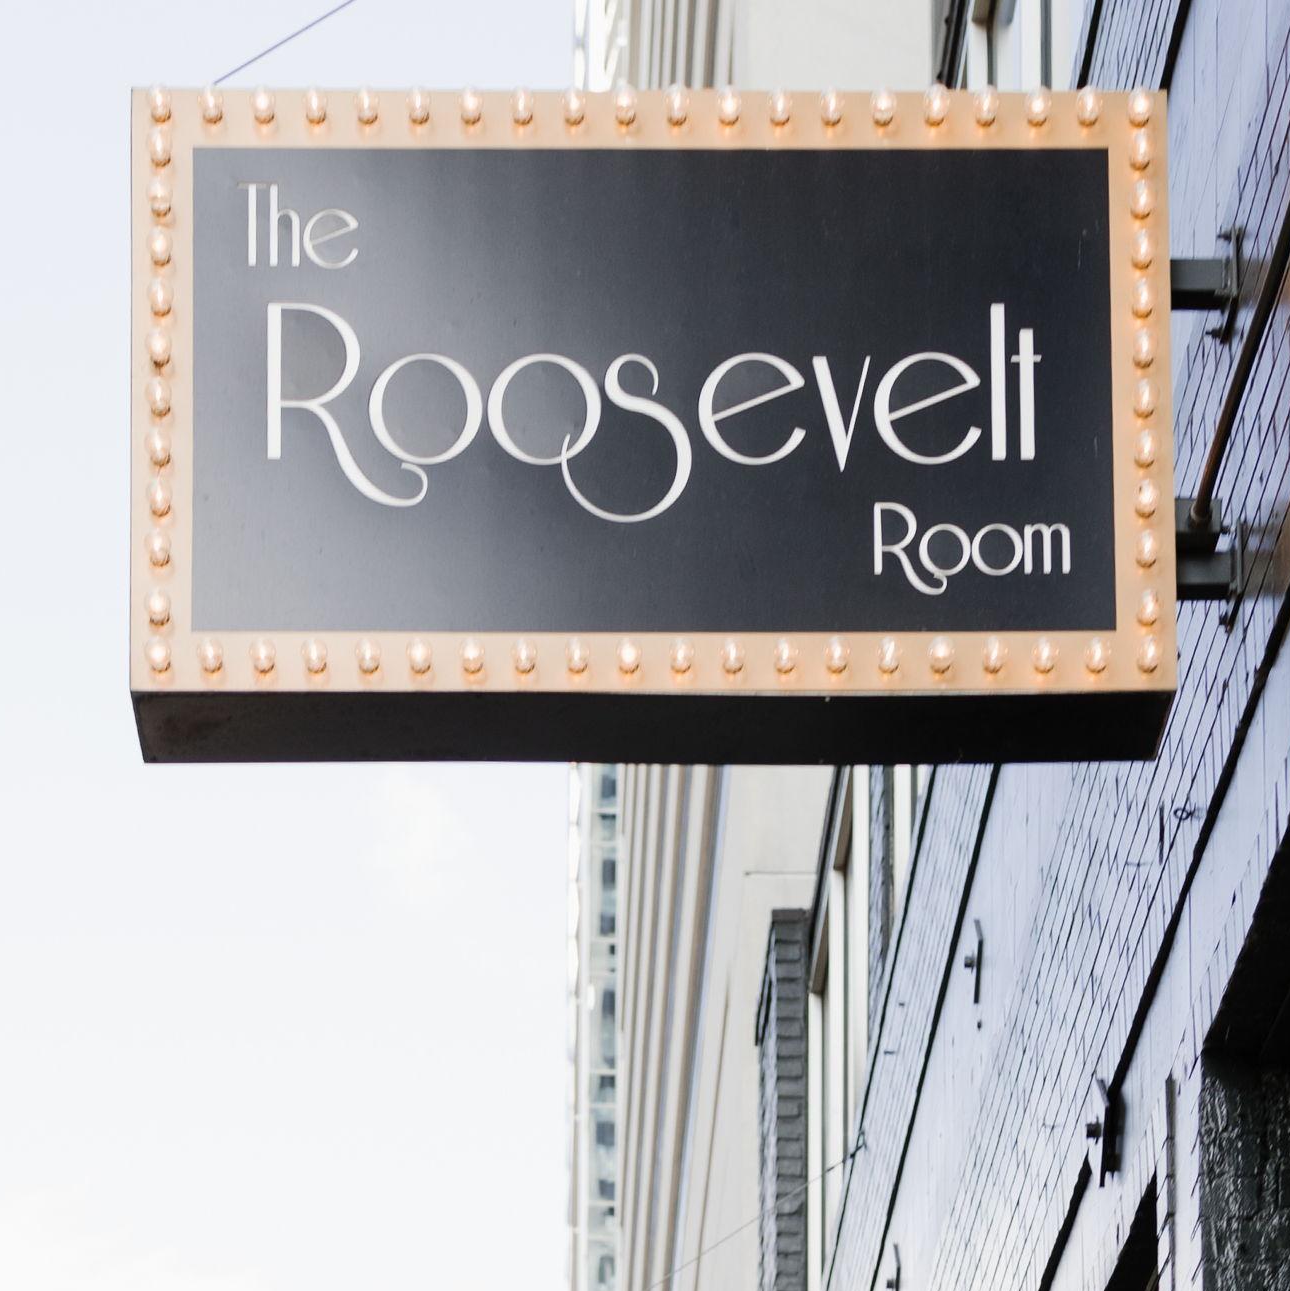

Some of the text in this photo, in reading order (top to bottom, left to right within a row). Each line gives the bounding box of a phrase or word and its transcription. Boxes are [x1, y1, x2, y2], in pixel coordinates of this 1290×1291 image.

[236, 182, 359, 269] The
[266, 302, 1041, 522] Roosevelt
[873, 502, 1070, 595] Room
